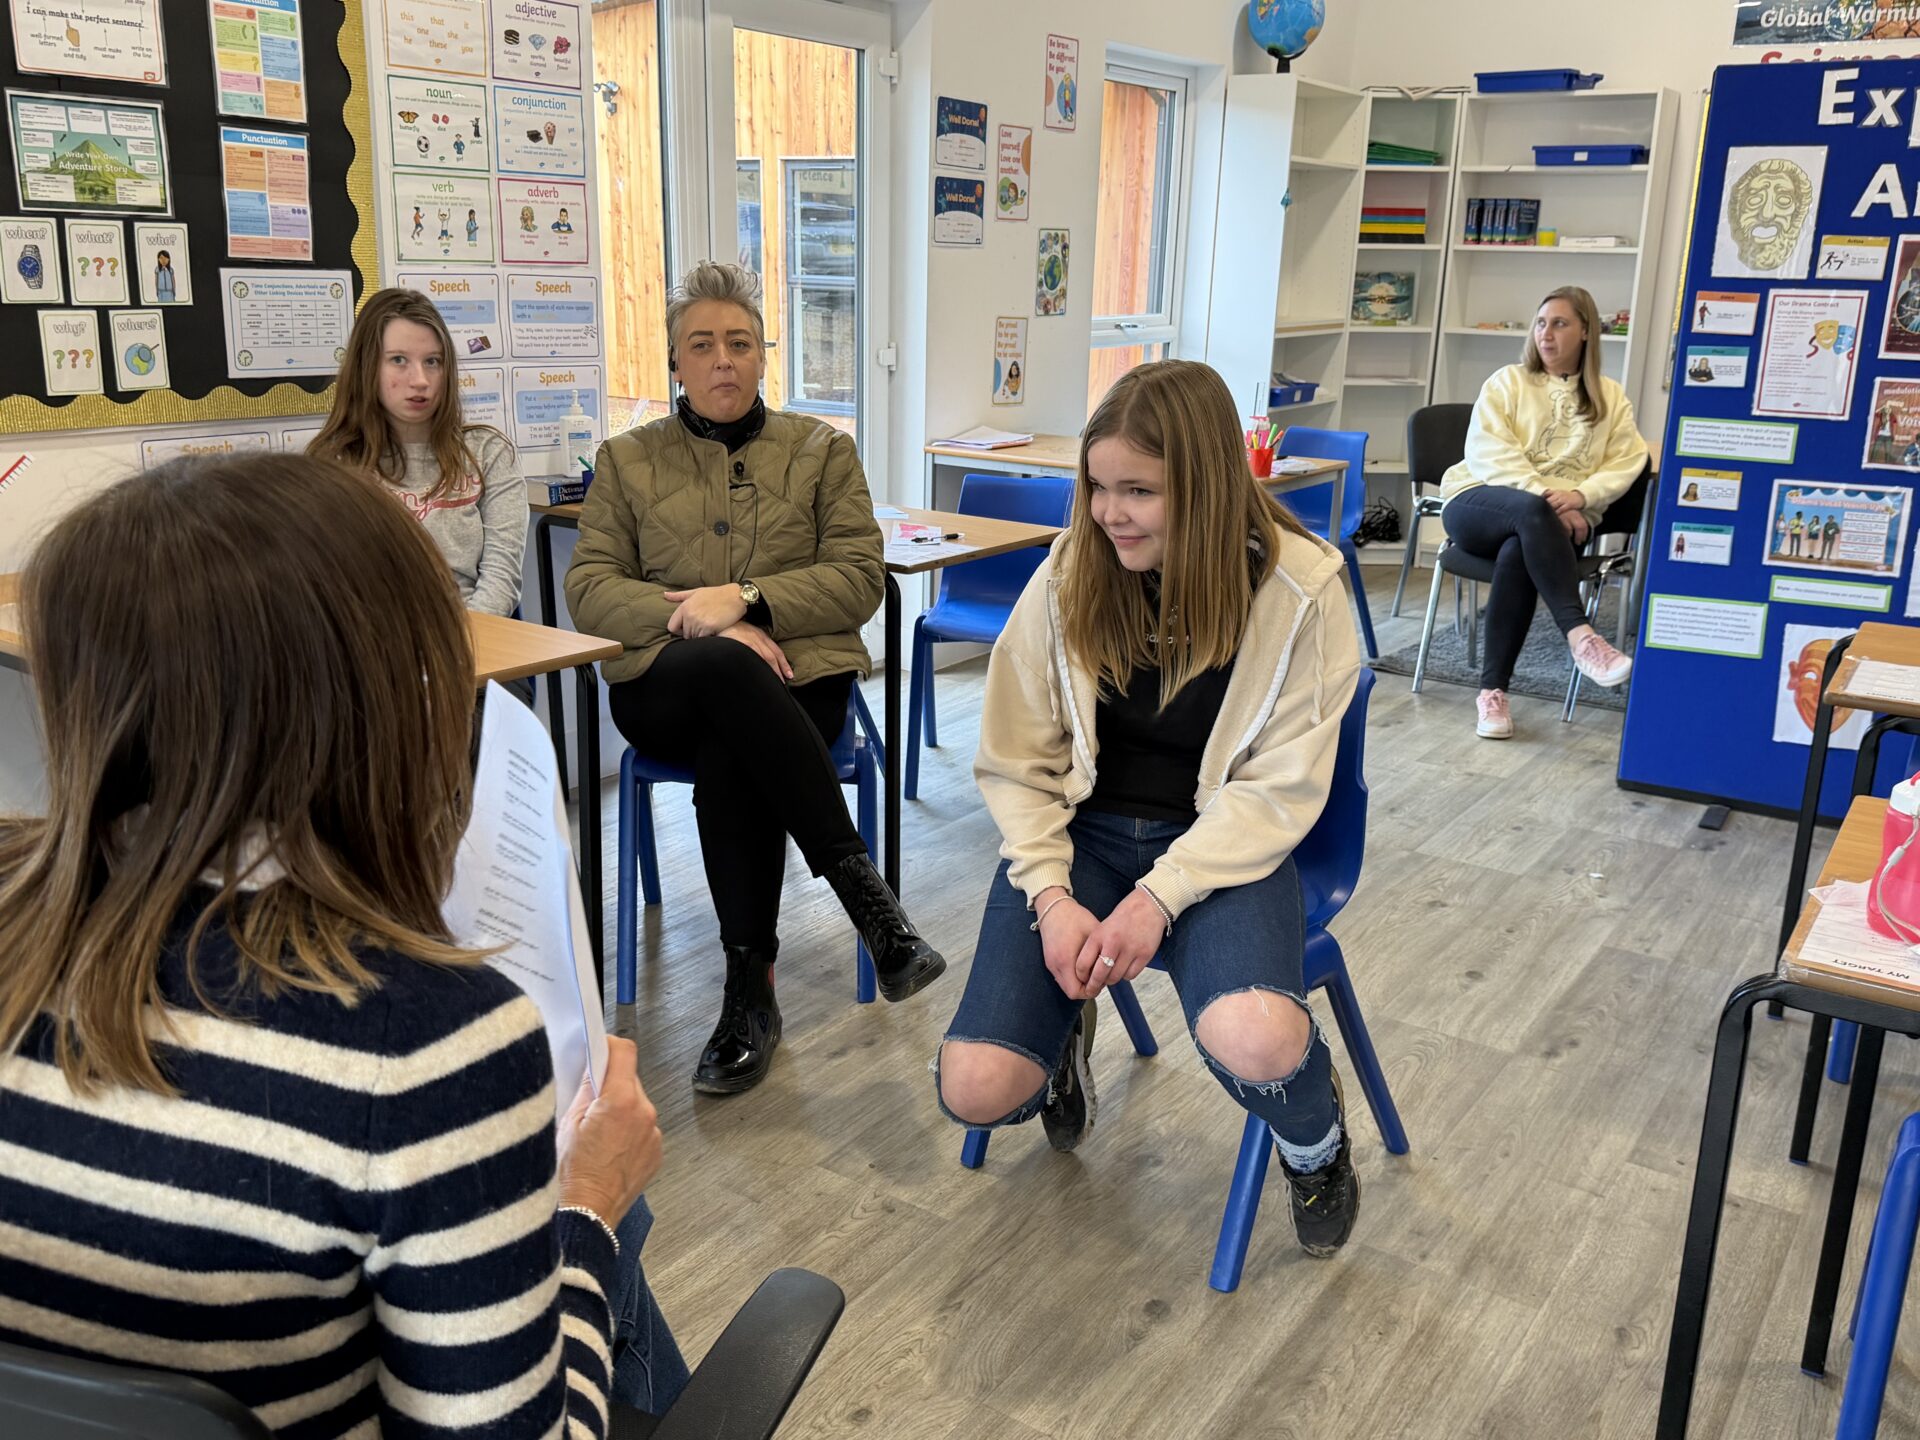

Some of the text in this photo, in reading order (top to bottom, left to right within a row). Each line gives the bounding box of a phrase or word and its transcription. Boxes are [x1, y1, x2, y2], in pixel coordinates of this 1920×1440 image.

[32, 8, 47, 16] can
[48, 9, 69, 19] make
[70, 11, 84, 21] the
[85, 14, 110, 25] perfect
[400, 11, 414, 21] this
[515, 2, 557, 19] adjective
[1760, 5, 1831, 29] Global
[430, 16, 445, 26] that
[463, 20, 469, 30] it
[416, 27, 429, 35] one
[447, 30, 458, 40] she
[403, 34, 413, 45] he
[429, 39, 448, 49] these
[1049, 39, 1056, 48] Be
[461, 46, 473, 54] you
[1048, 51, 1056, 60] Be
[1048, 63, 1055, 72] Be
[426, 87, 453, 99] noun
[512, 95, 567, 111] conjunction
[948, 113, 962, 125] Well
[241, 133, 288, 146] Punctuation
[1001, 128, 1012, 138] Love
[65, 151, 84, 159] Write
[1000, 153, 1021, 164] Love one
[58, 160, 128, 175] Adventure Story
[432, 180, 454, 193] verb
[527, 185, 559, 199] adverb
[945, 192, 959, 202] Well
[5, 225, 48, 240] when?
[75, 230, 114, 244] what?
[146, 232, 177, 247] who?
[429, 278, 471, 296] Speech
[535, 280, 572, 297] Speech
[53, 320, 87, 338] why?
[117, 318, 157, 333] where?
[458, 374, 476, 388] ech
[538, 370, 576, 386] Speech
[1832, 958, 1910, 980] MY TARGET
